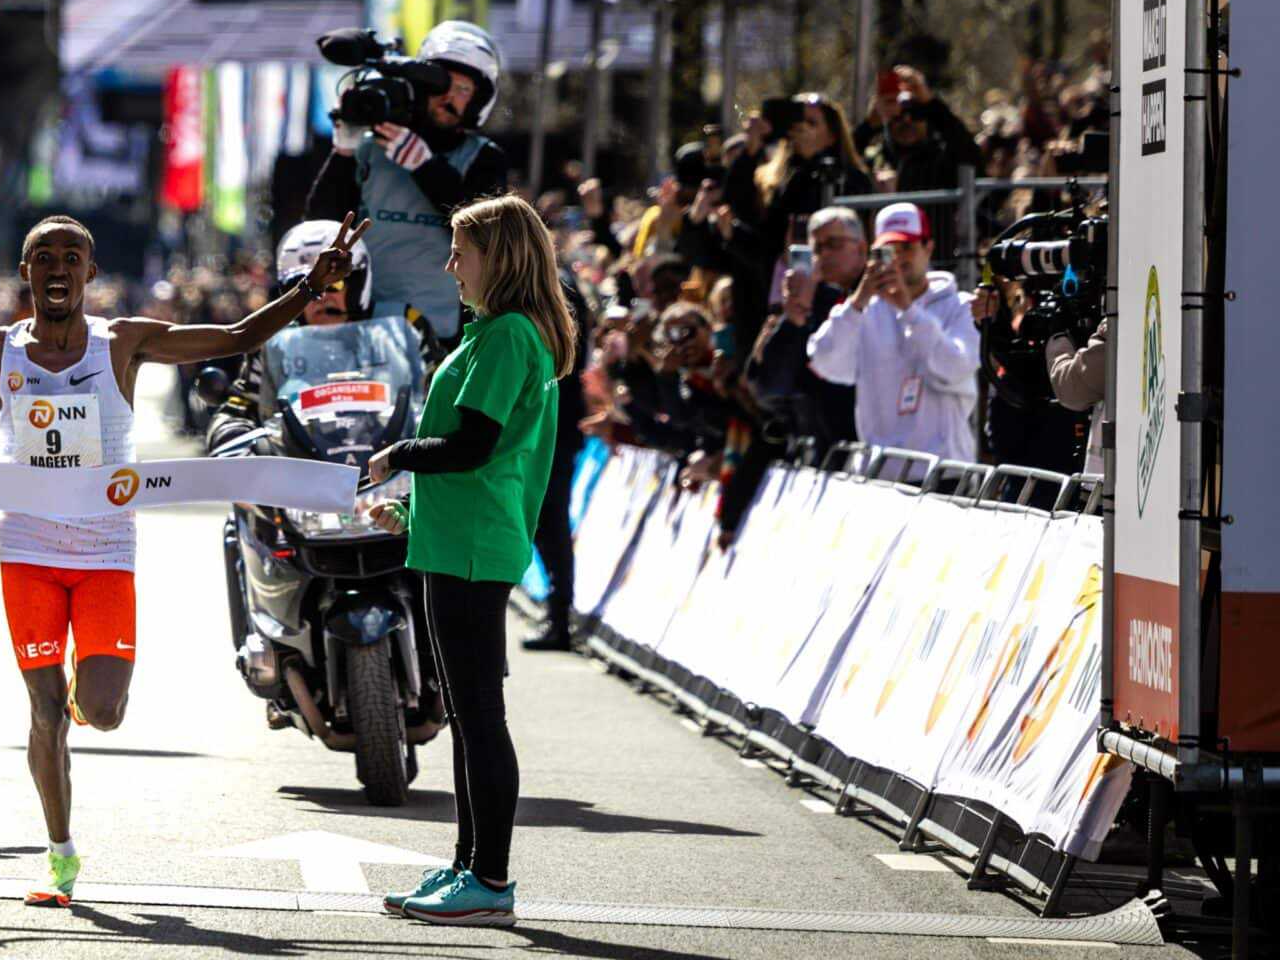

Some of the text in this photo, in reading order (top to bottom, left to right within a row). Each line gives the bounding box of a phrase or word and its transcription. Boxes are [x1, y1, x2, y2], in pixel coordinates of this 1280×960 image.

[58, 406, 86, 420] NN
[46, 429, 61, 455] 9
[30, 455, 81, 468] NAGEEYE
[146, 476, 171, 488] NN
